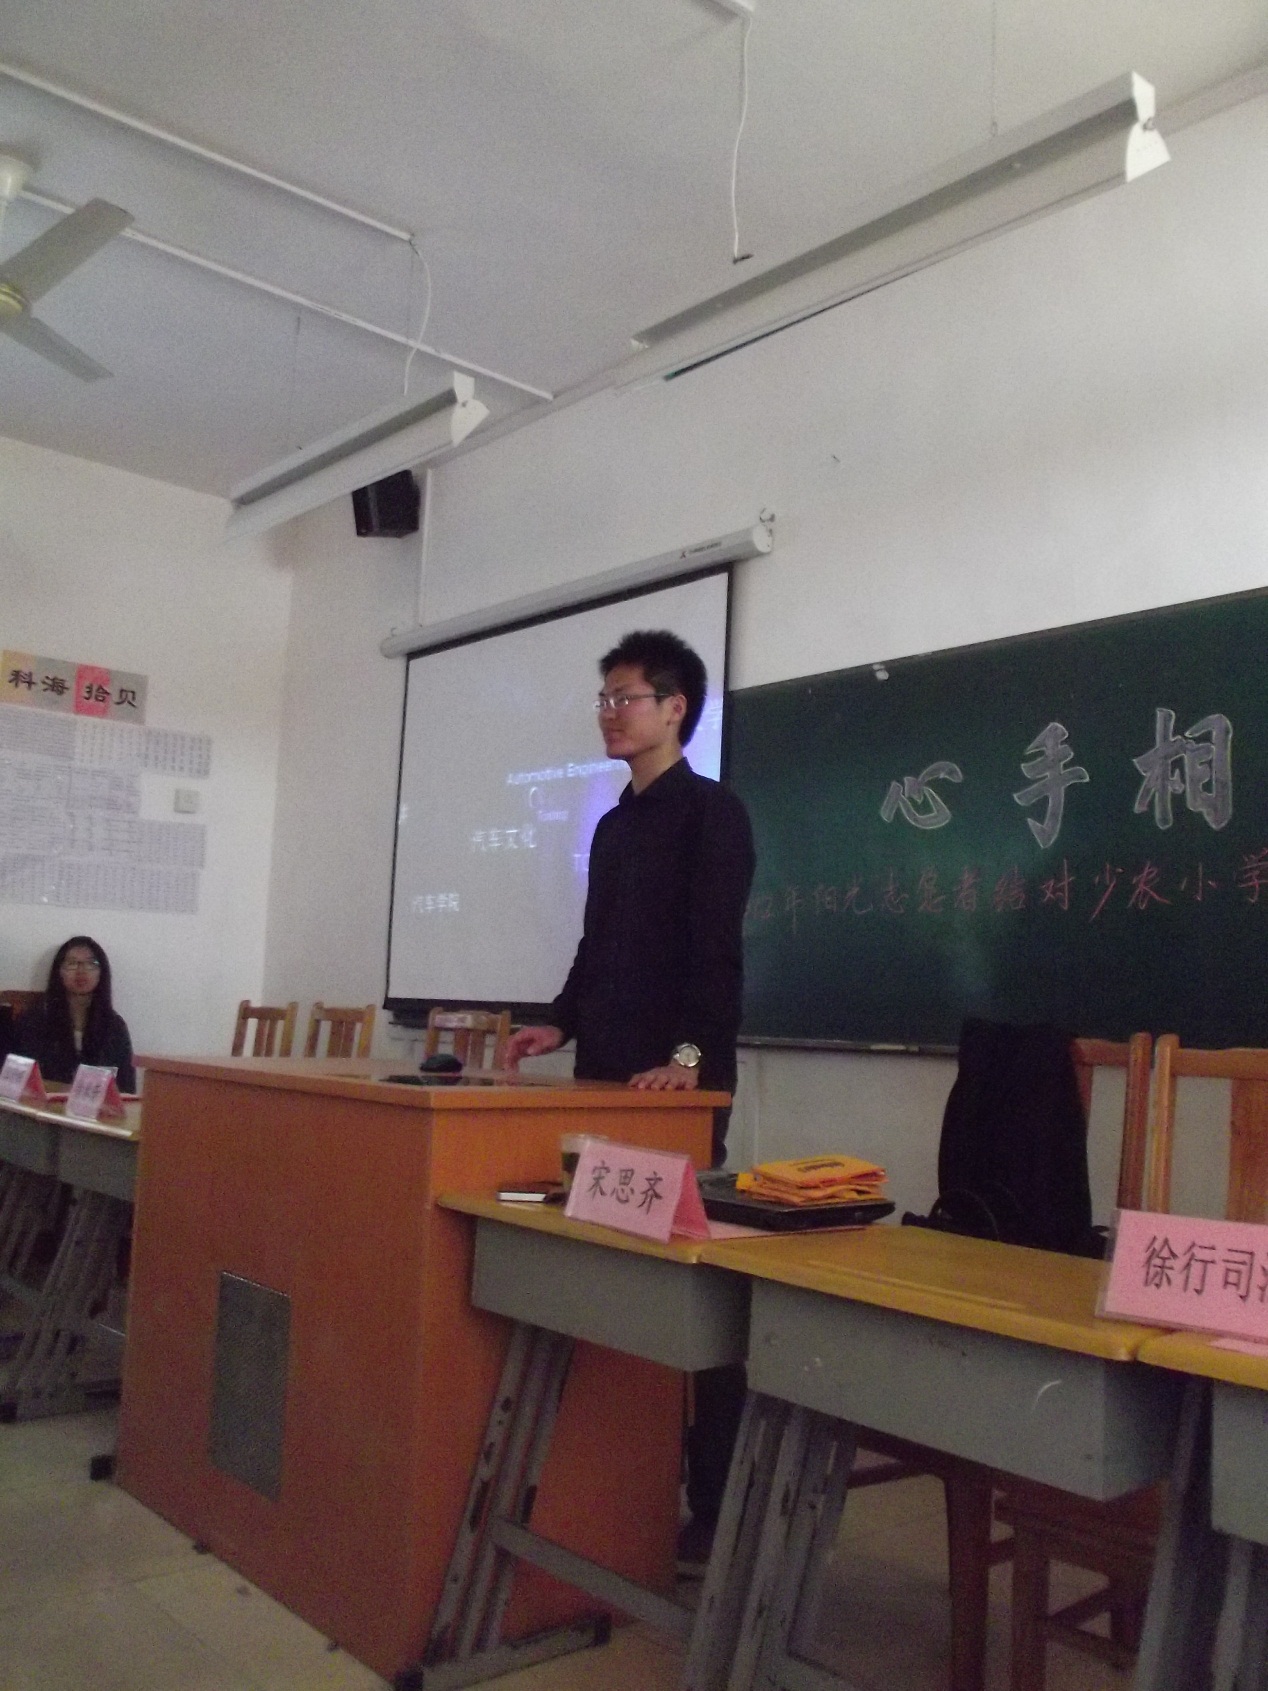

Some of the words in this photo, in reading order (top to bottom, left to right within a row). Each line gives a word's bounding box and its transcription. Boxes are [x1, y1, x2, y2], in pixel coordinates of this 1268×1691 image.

[8, 669, 137, 708] 科海拾贝
[880, 708, 1233, 849] 心手相
[587, 1160, 663, 1214] 宋思齐
